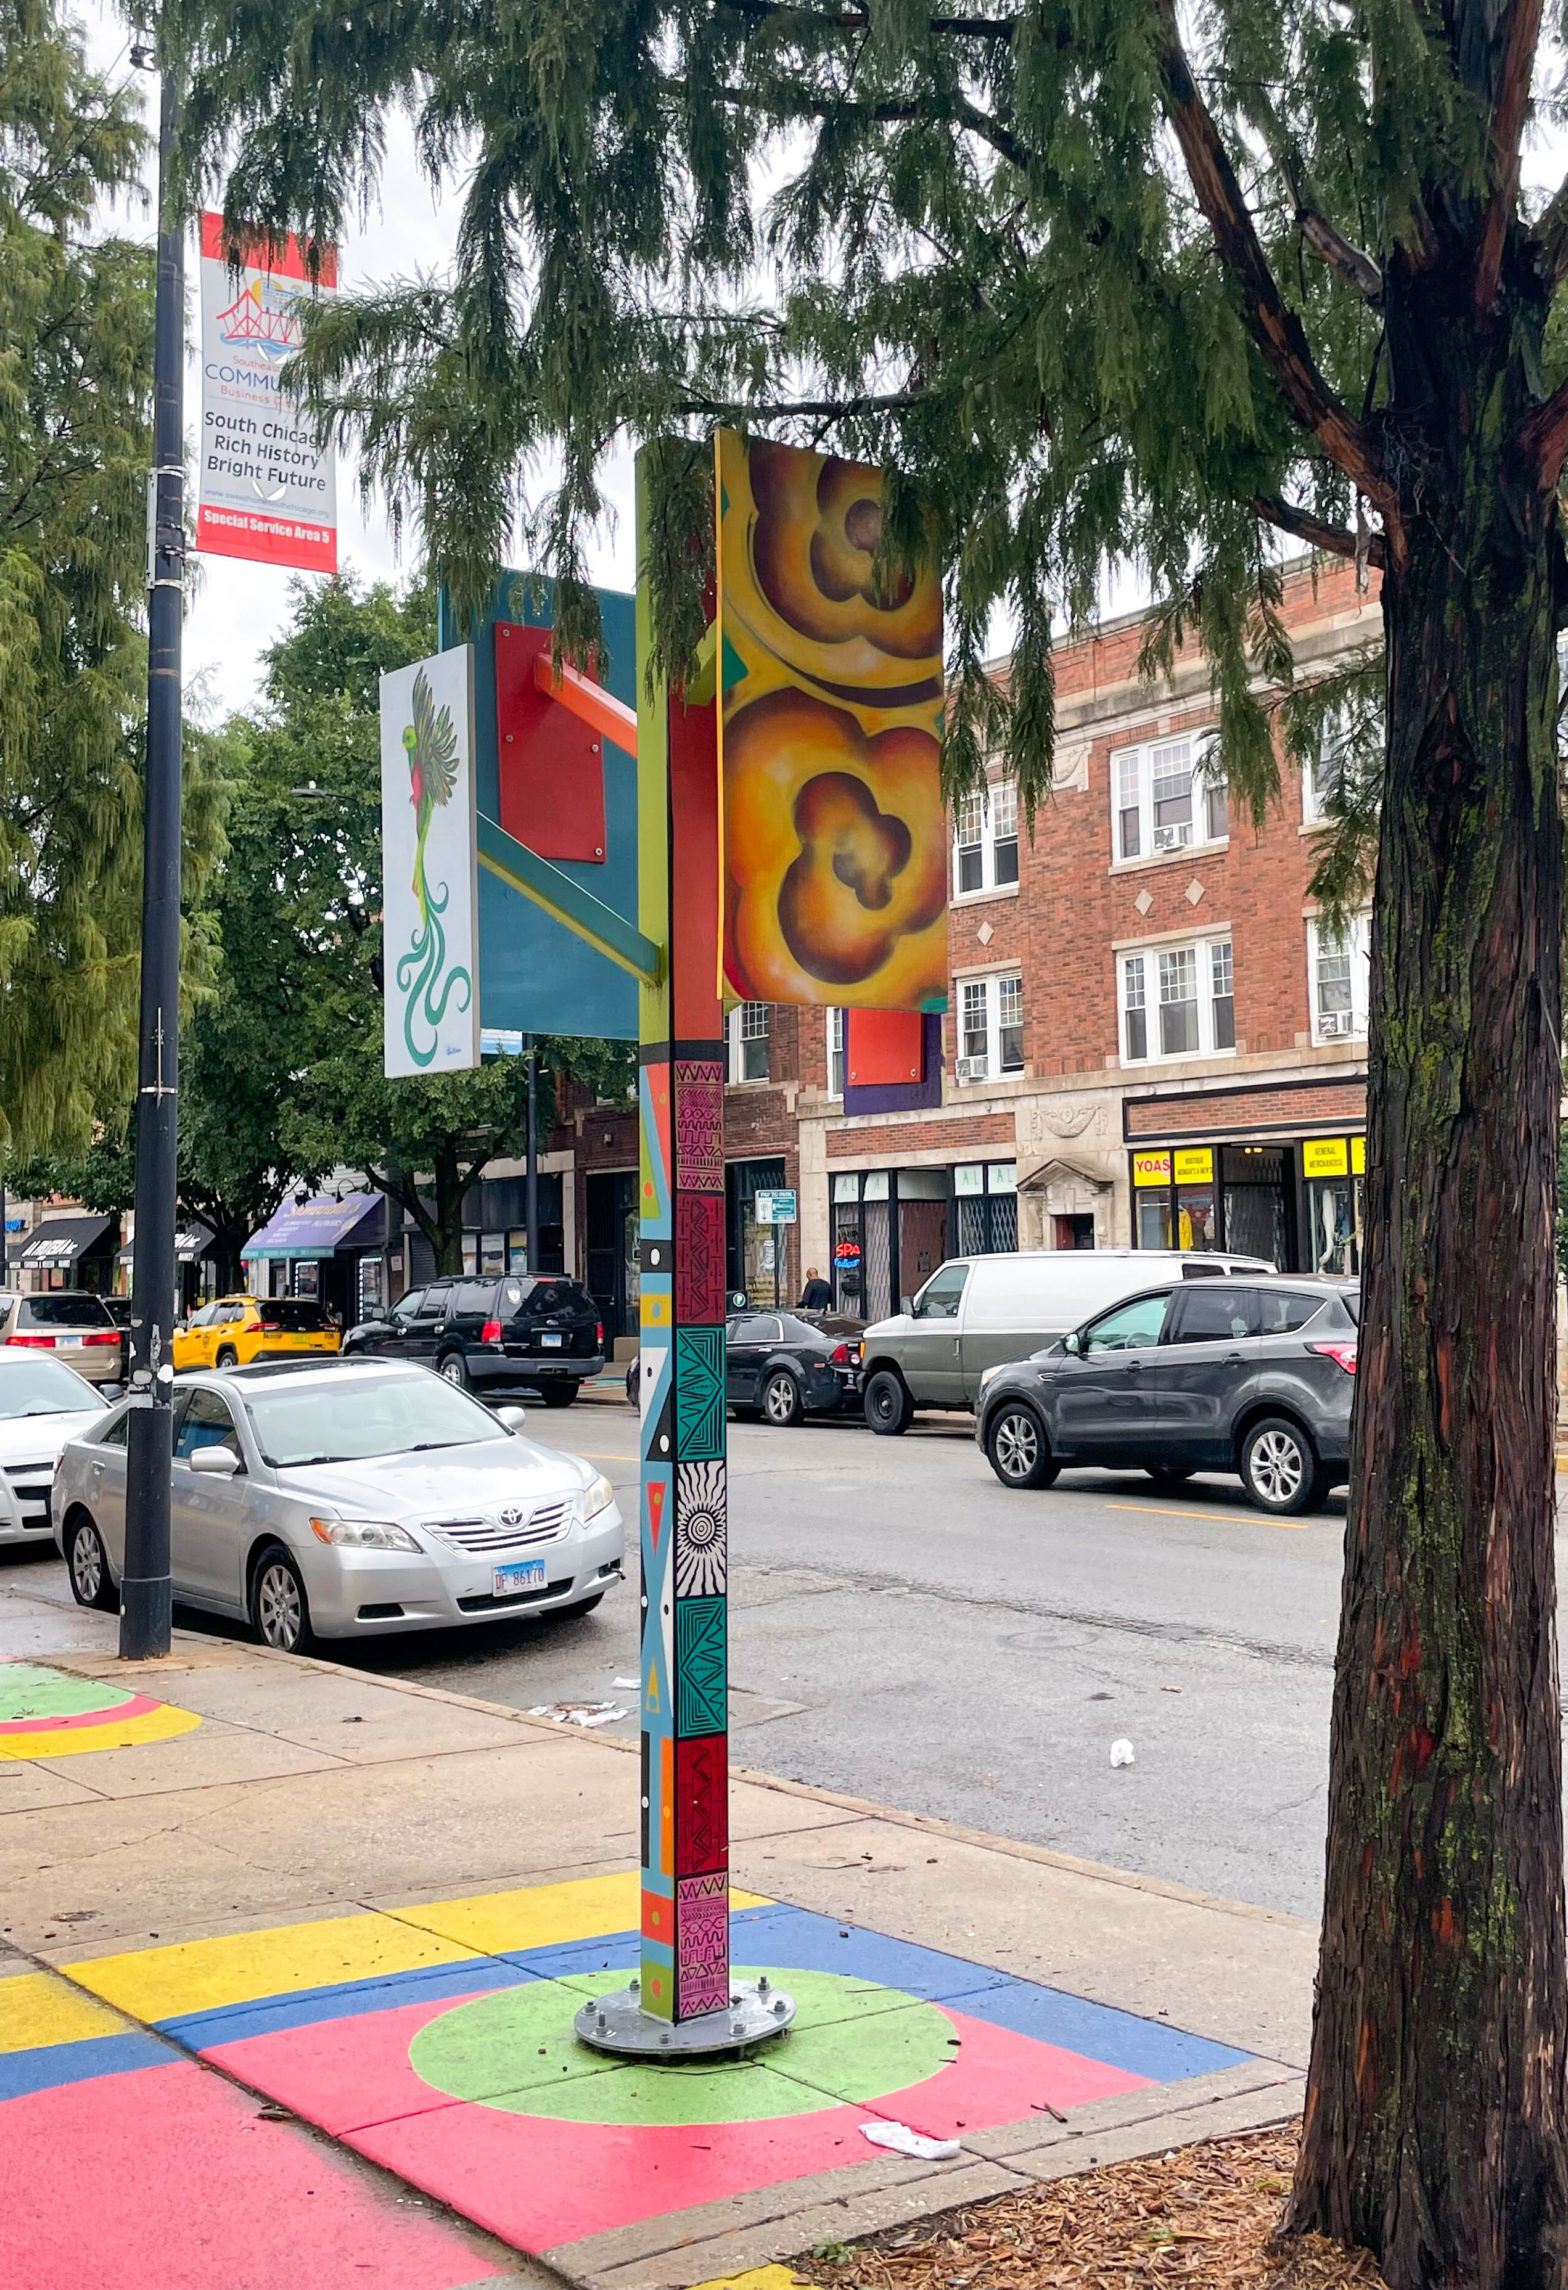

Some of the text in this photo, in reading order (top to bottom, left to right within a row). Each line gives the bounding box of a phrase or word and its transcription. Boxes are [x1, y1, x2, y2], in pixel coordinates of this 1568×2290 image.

[233, 355, 281, 373] Southeast
[220, 385, 270, 404] Business
[204, 411, 321, 449] South Chicag
[214, 435, 319, 470] Rich History
[207, 456, 326, 491] Bright Future
[204, 509, 330, 544] Special Service Area 5
[1136, 1159, 1171, 1173] YOAS
[836, 1243, 860, 1257] SPA
